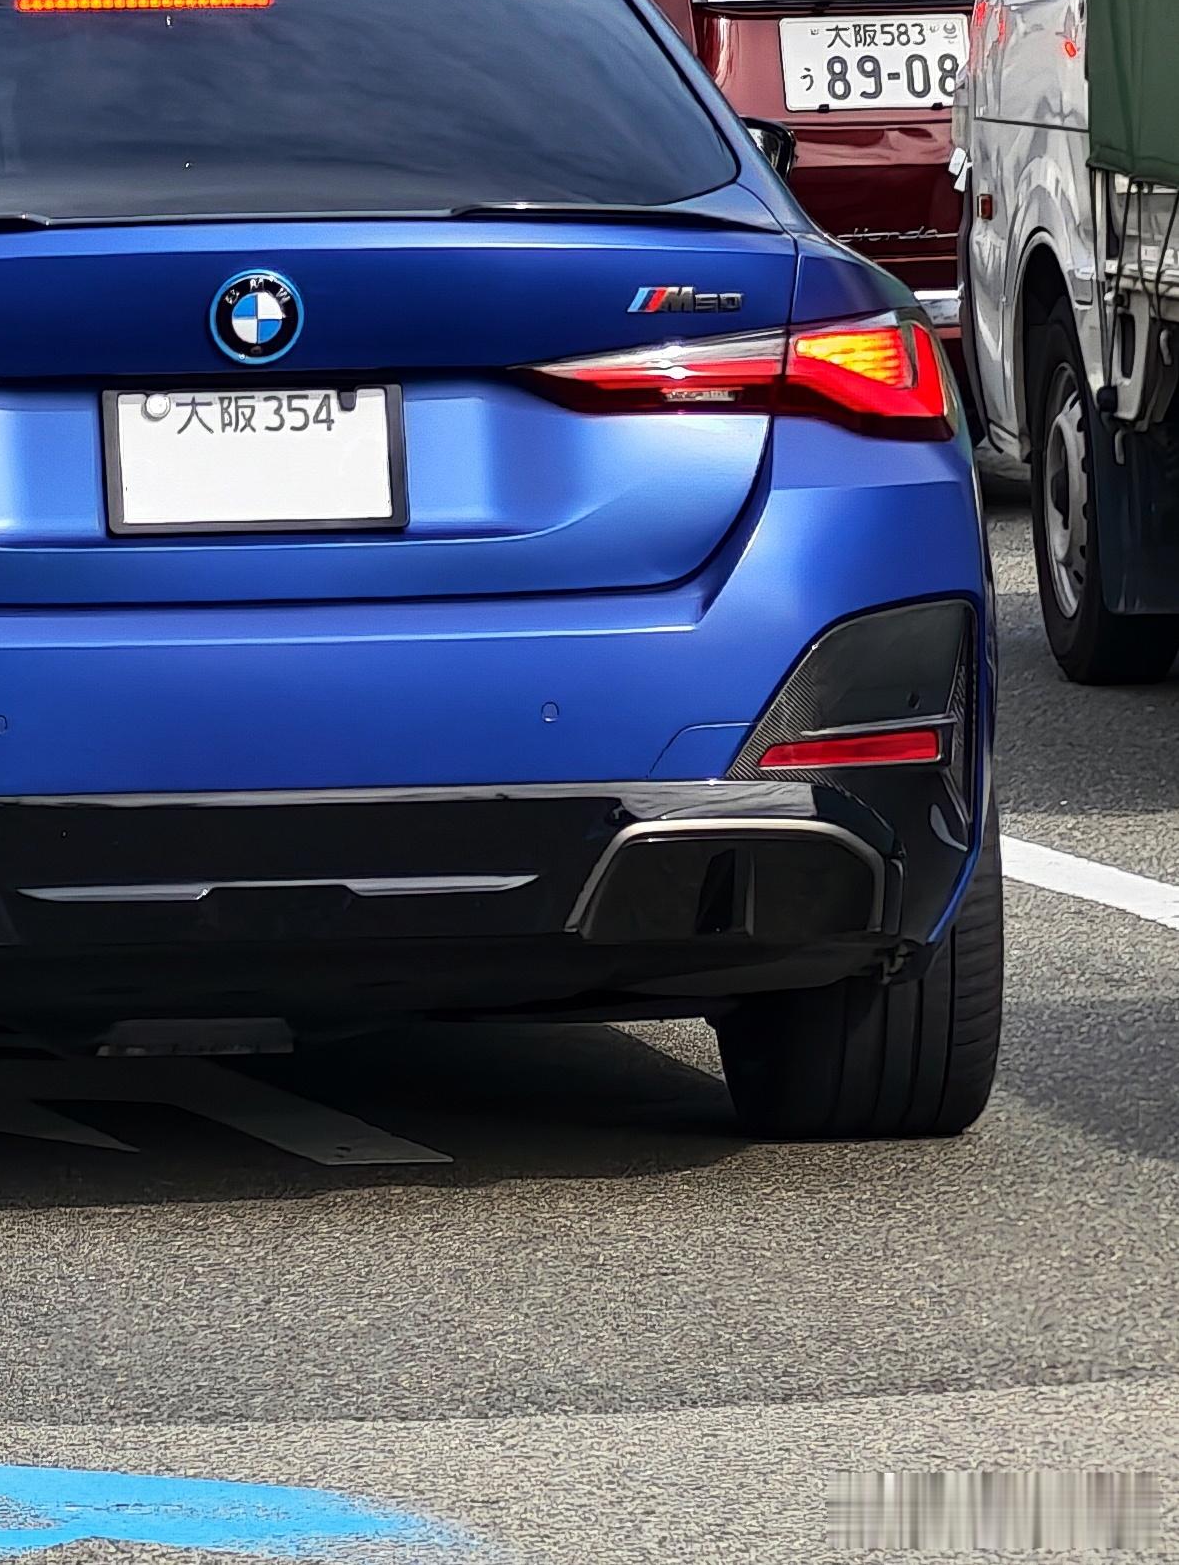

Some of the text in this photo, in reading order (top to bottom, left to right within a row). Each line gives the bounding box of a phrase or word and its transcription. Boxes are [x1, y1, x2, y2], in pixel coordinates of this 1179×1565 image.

[825, 23, 927, 49] 大阪583
[800, 53, 959, 101] う 89-08
[224, 276, 291, 306] BMW
[175, 393, 335, 435] 大阪354
